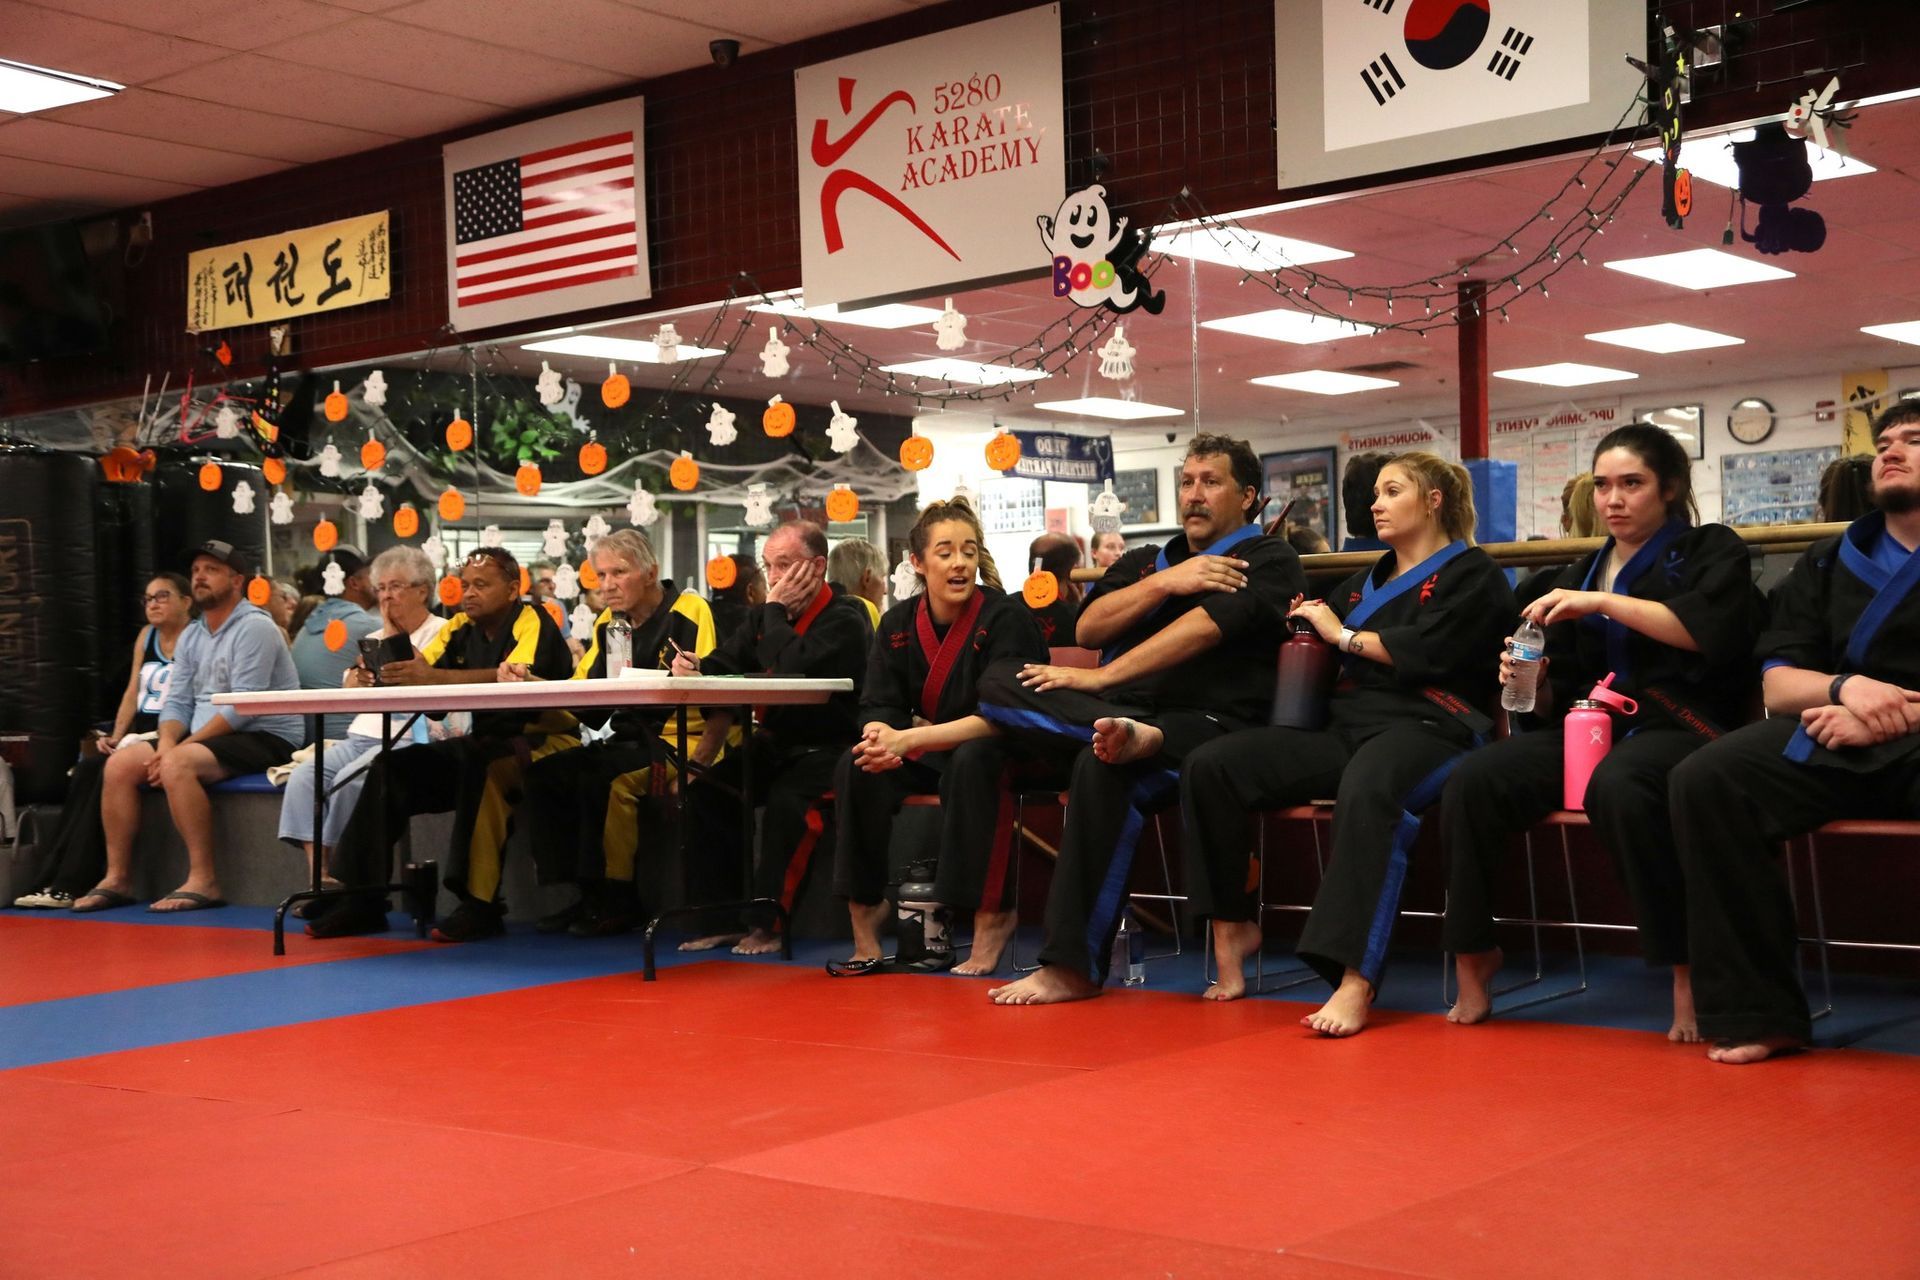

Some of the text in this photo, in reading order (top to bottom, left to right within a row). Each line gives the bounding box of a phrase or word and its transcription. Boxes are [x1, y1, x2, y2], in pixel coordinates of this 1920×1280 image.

[932, 72, 1002, 115] 5280
[905, 101, 1034, 155] KARATE
[900, 126, 1048, 192] ACADEMY
